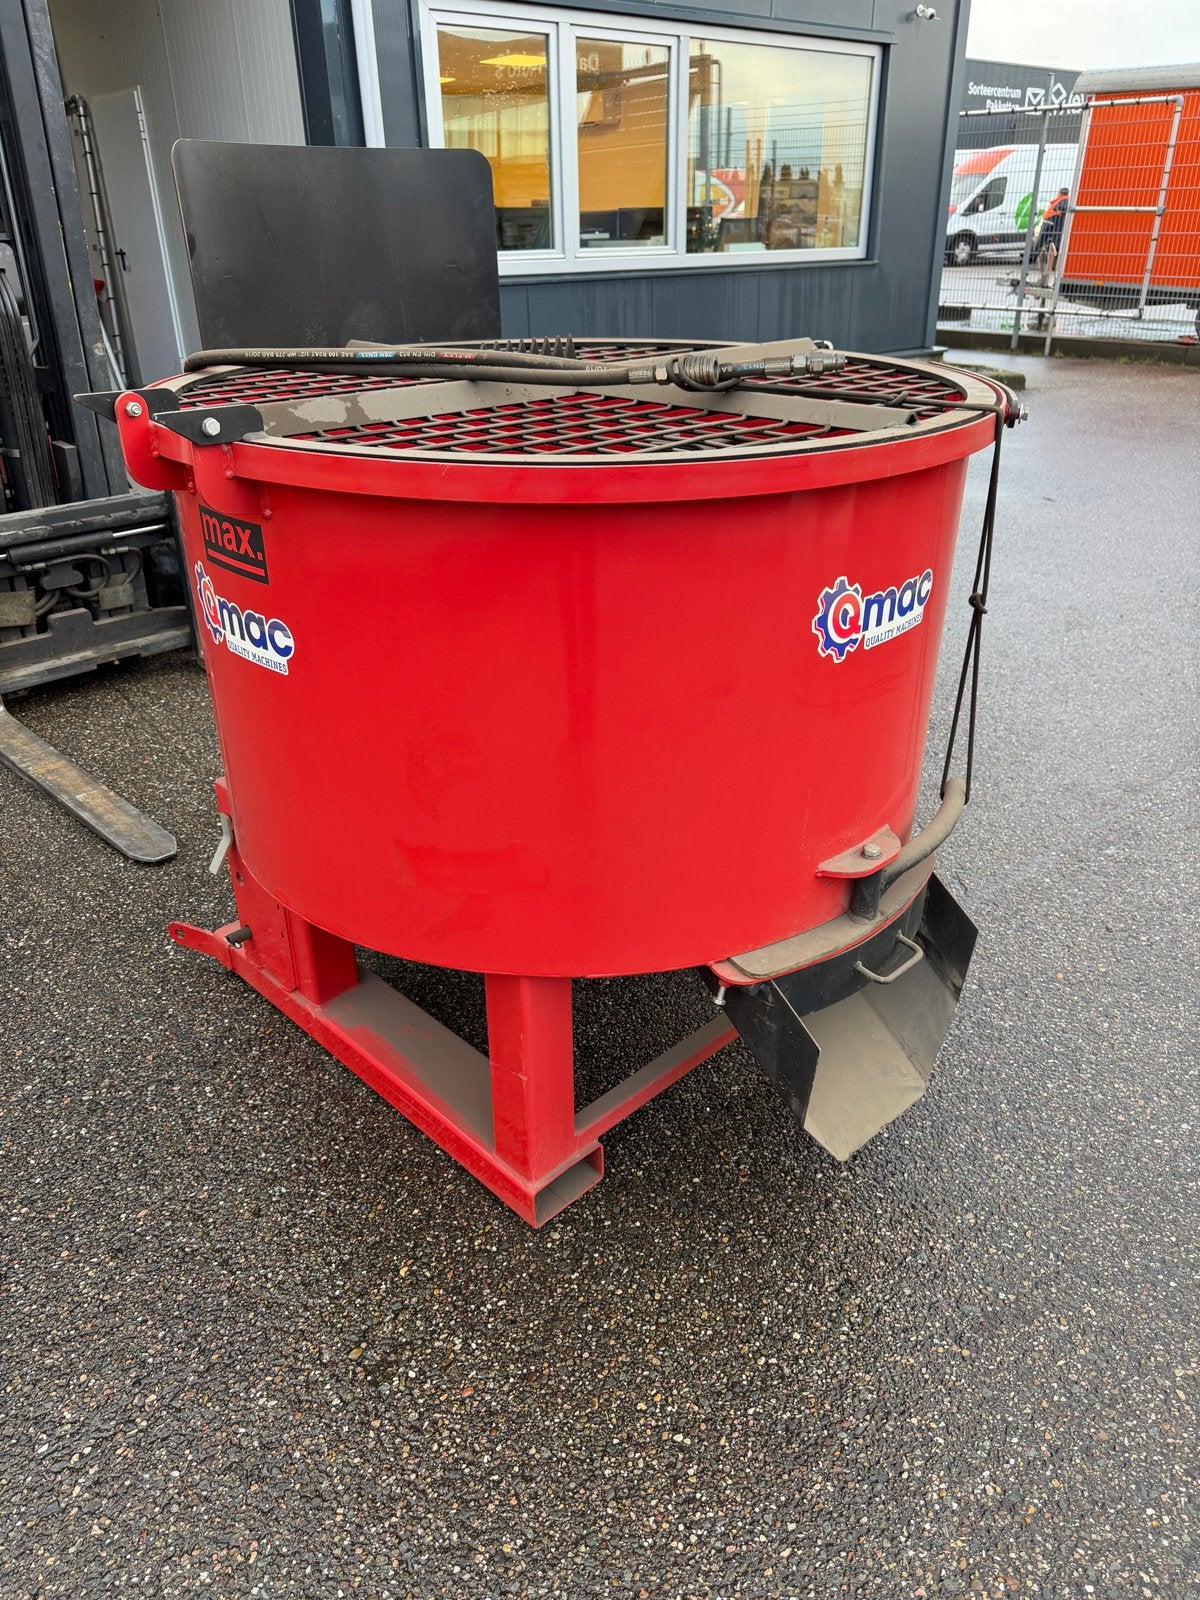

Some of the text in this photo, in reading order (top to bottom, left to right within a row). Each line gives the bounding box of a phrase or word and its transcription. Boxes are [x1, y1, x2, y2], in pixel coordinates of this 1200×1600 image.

[967, 81, 1022, 99] Sorteercentrum
[202, 512, 263, 561] max.
[865, 611, 923, 648] QUALITY MACHINES
[227, 639, 288, 674] QUALITY MACHINES
